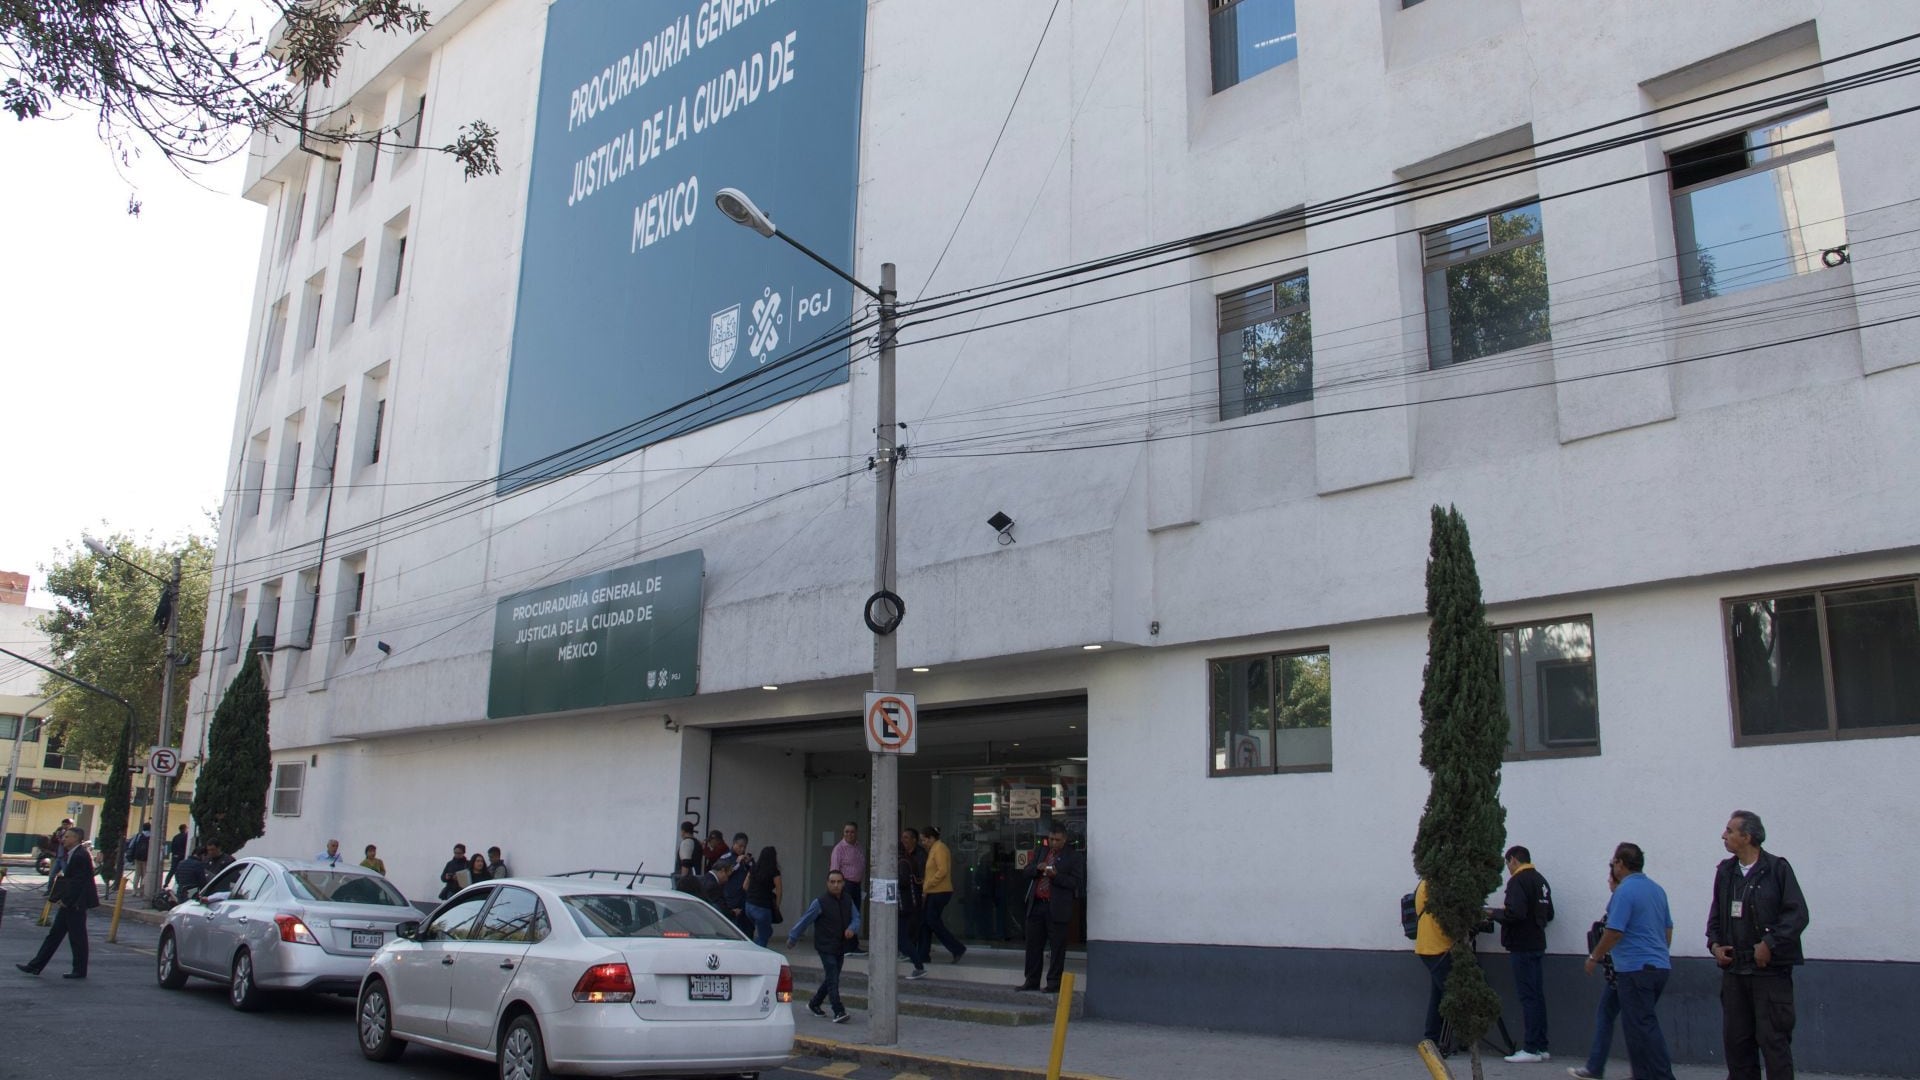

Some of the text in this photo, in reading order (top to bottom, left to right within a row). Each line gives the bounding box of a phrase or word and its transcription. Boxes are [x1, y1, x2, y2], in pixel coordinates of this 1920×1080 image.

[568, 0, 777, 132] PROCURADURÍA GENE
[568, 30, 796, 207] JUSTICIA DE LA CIUDAD DE
[631, 175, 698, 253] MÉXICO
[798, 289, 831, 321] PGJ
[513, 576, 662, 621] PROCURADURÍA GENERAL DE
[515, 605, 653, 644] JUSTICIA DE LA CIUDAD DE
[558, 641, 598, 661] MÉXICO
[883, 708, 899, 738] E
[158, 754, 170, 769] E
[685, 797, 701, 828] 5
